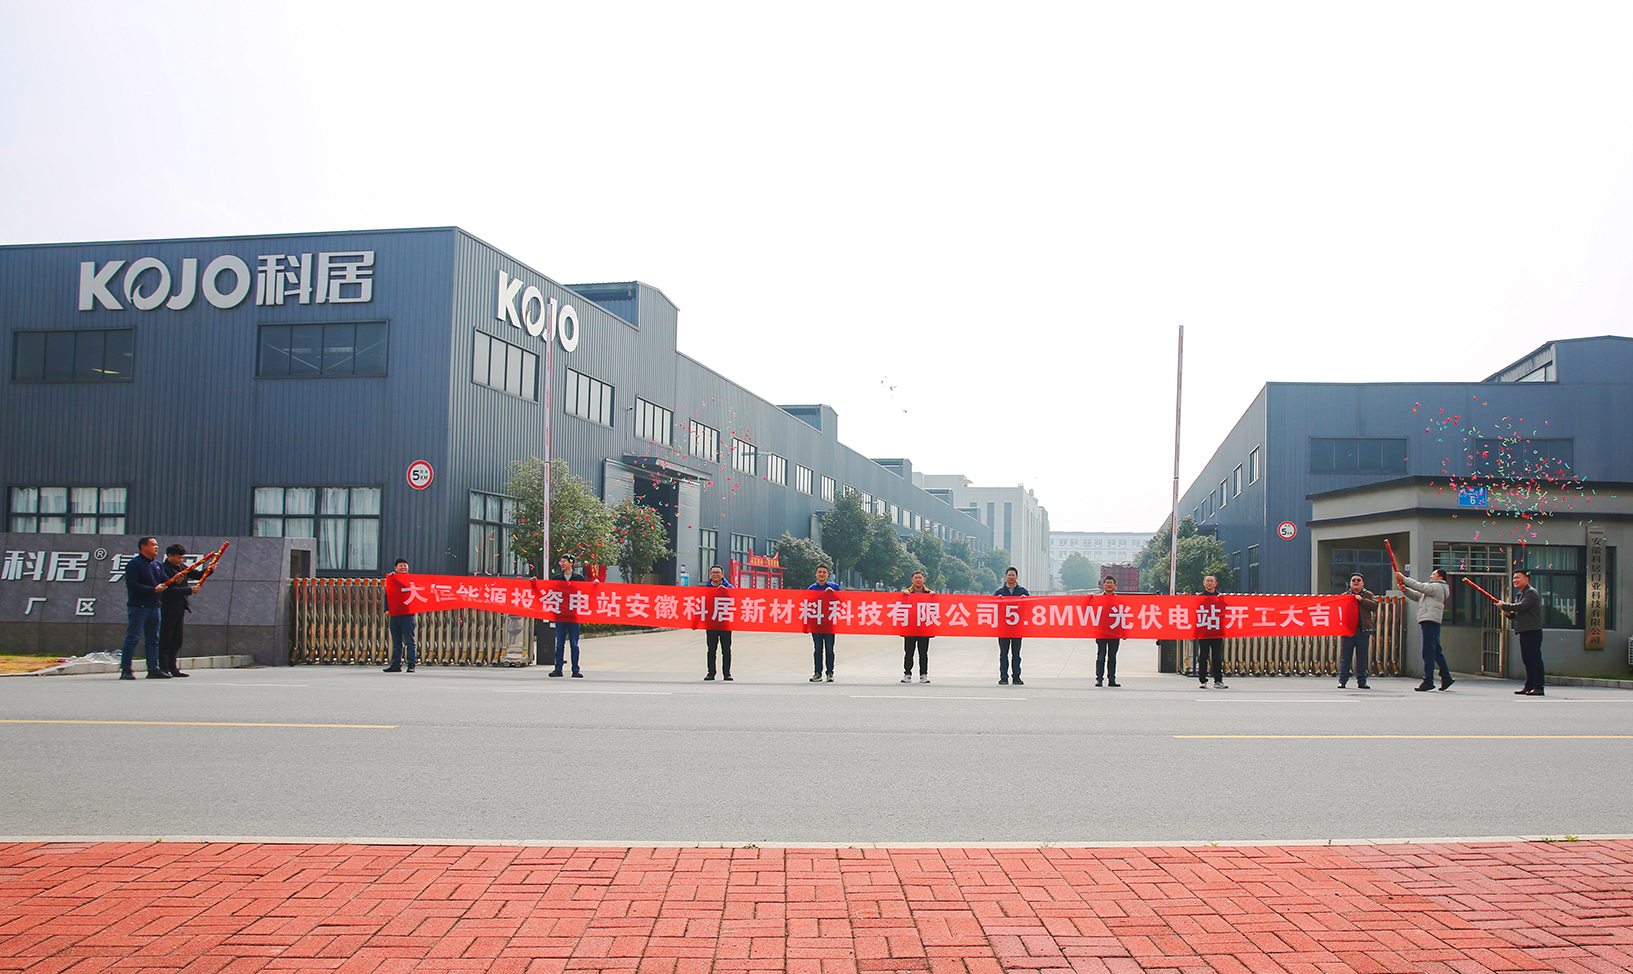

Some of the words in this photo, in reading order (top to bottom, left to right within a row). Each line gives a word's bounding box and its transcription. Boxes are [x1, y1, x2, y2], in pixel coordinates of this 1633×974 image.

[497, 269, 580, 353] KOJO
[412, 470, 420, 481] 5
[1281, 527, 1287, 536] 5
[24, 597, 97, 616] 厂区
